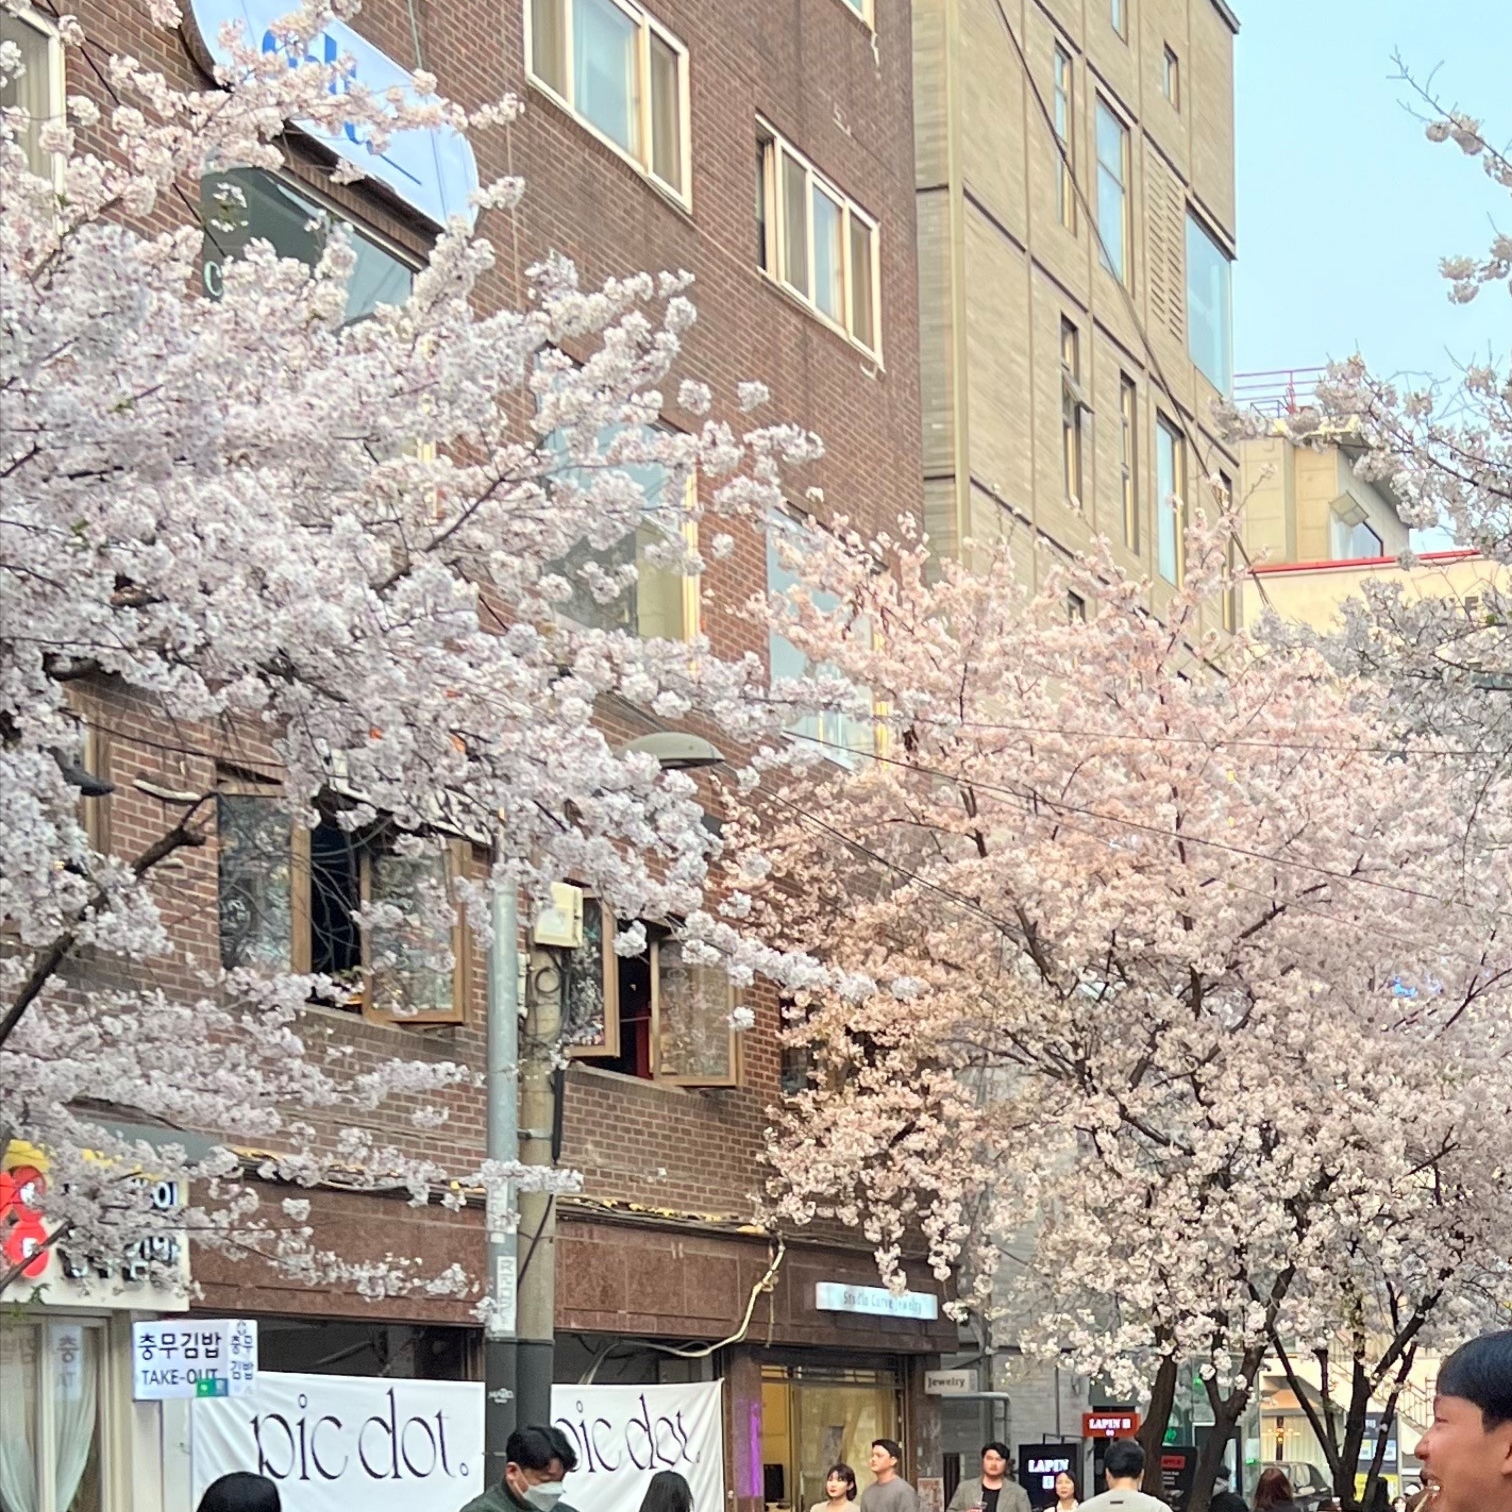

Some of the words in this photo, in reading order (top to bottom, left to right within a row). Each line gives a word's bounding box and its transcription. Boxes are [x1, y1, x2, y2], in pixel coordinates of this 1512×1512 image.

[137, 1332, 222, 1361] 충무김밥
[141, 1368, 219, 1385] TAKE-OUT
[1088, 1418, 1121, 1430] LAPIN
[250, 1393, 349, 1481] pic
[1027, 1458, 1070, 1473] LAPIN
